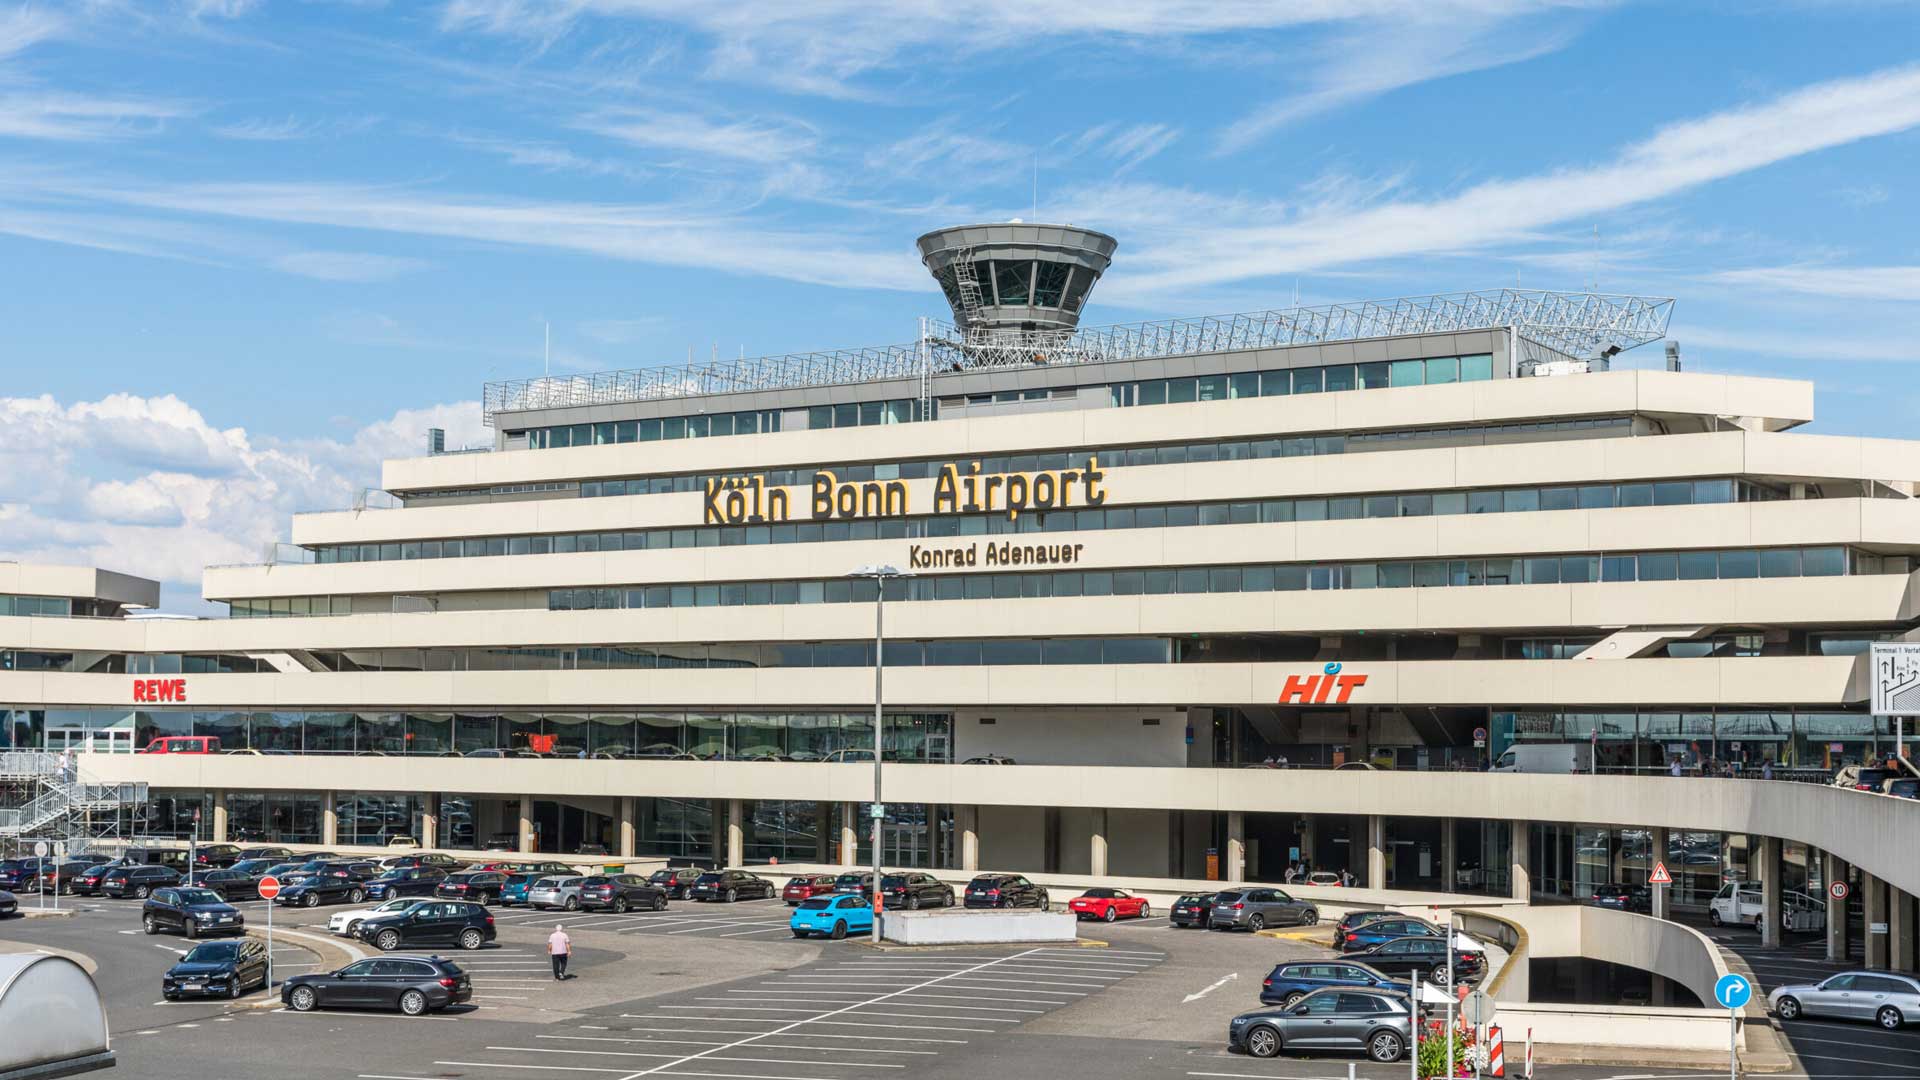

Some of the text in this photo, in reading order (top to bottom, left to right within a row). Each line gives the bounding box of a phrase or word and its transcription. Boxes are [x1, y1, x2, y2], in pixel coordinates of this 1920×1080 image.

[703, 456, 1109, 524] Köln Bonn Airport
[909, 541, 1084, 569] Konrad Adenauer
[133, 679, 187, 702] REWE
[1834, 885, 1844, 895] 10
